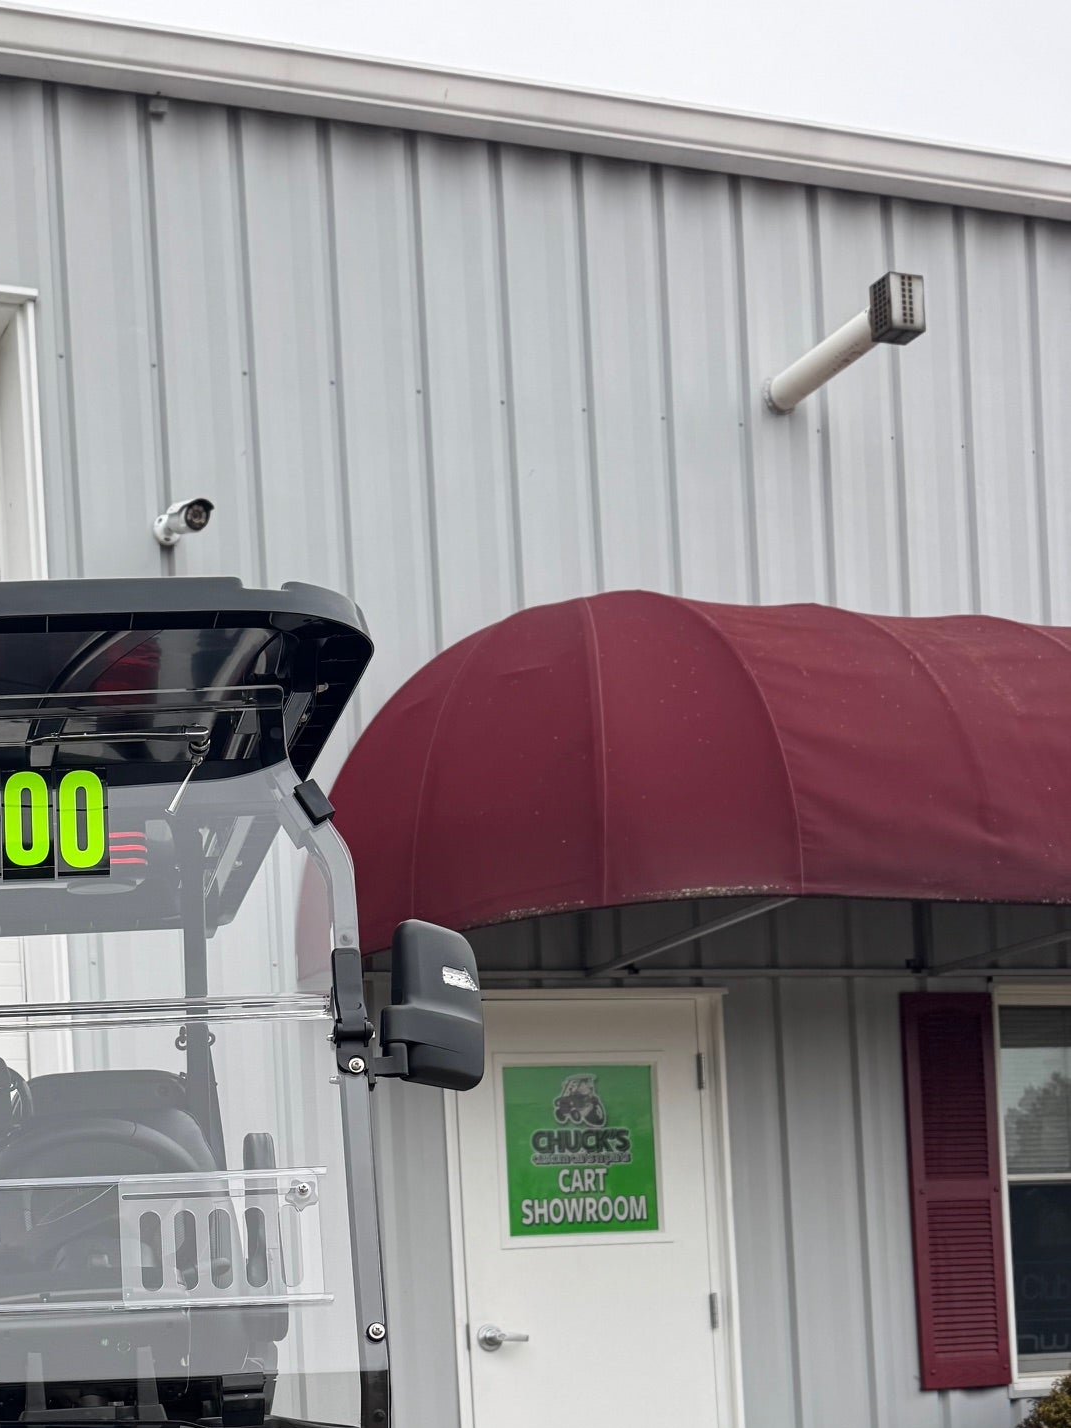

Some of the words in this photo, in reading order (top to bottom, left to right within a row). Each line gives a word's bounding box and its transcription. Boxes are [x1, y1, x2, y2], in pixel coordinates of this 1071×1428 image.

[531, 1128, 631, 1154] CHUCK'S
[558, 1168, 607, 1193] CART
[521, 1195, 648, 1225] SHOWROOM
